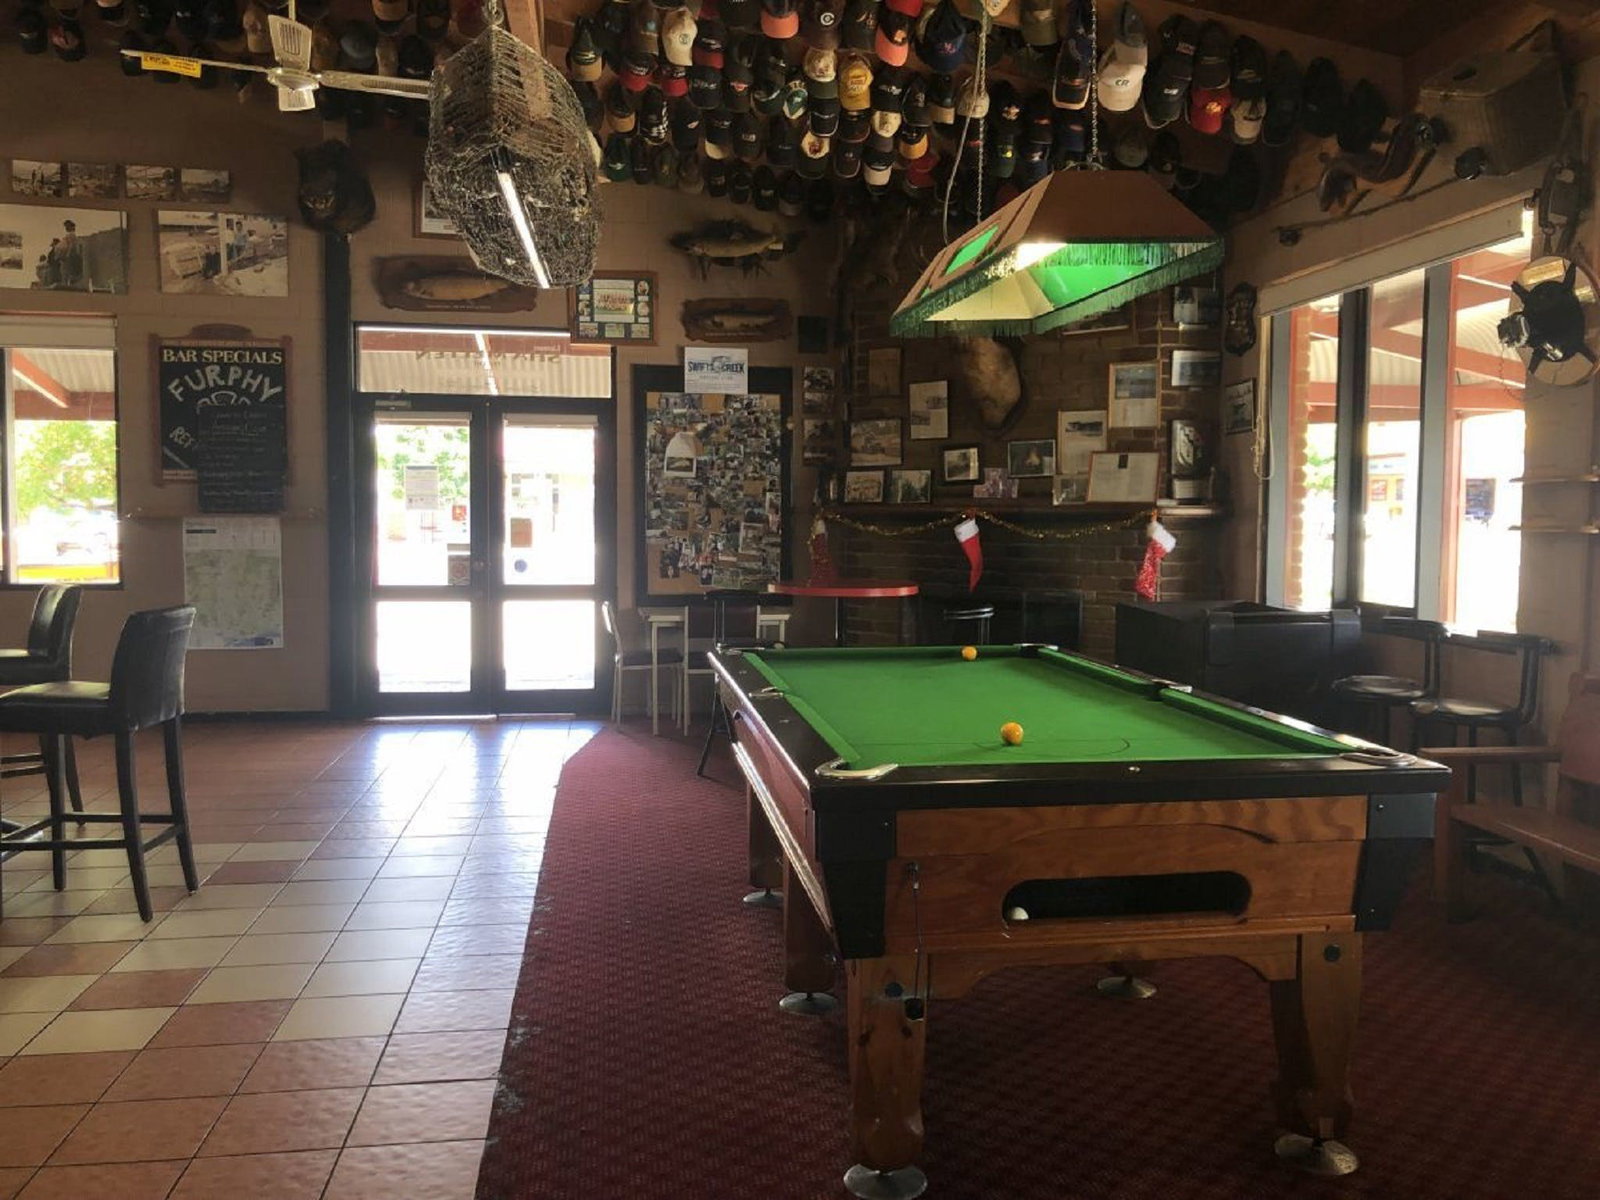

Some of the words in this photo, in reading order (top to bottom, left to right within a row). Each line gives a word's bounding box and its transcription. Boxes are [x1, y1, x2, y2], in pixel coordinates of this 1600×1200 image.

[163, 349, 197, 362] BAR
[202, 350, 283, 364] SPECIALS
[167, 365, 283, 401] FURPHY
